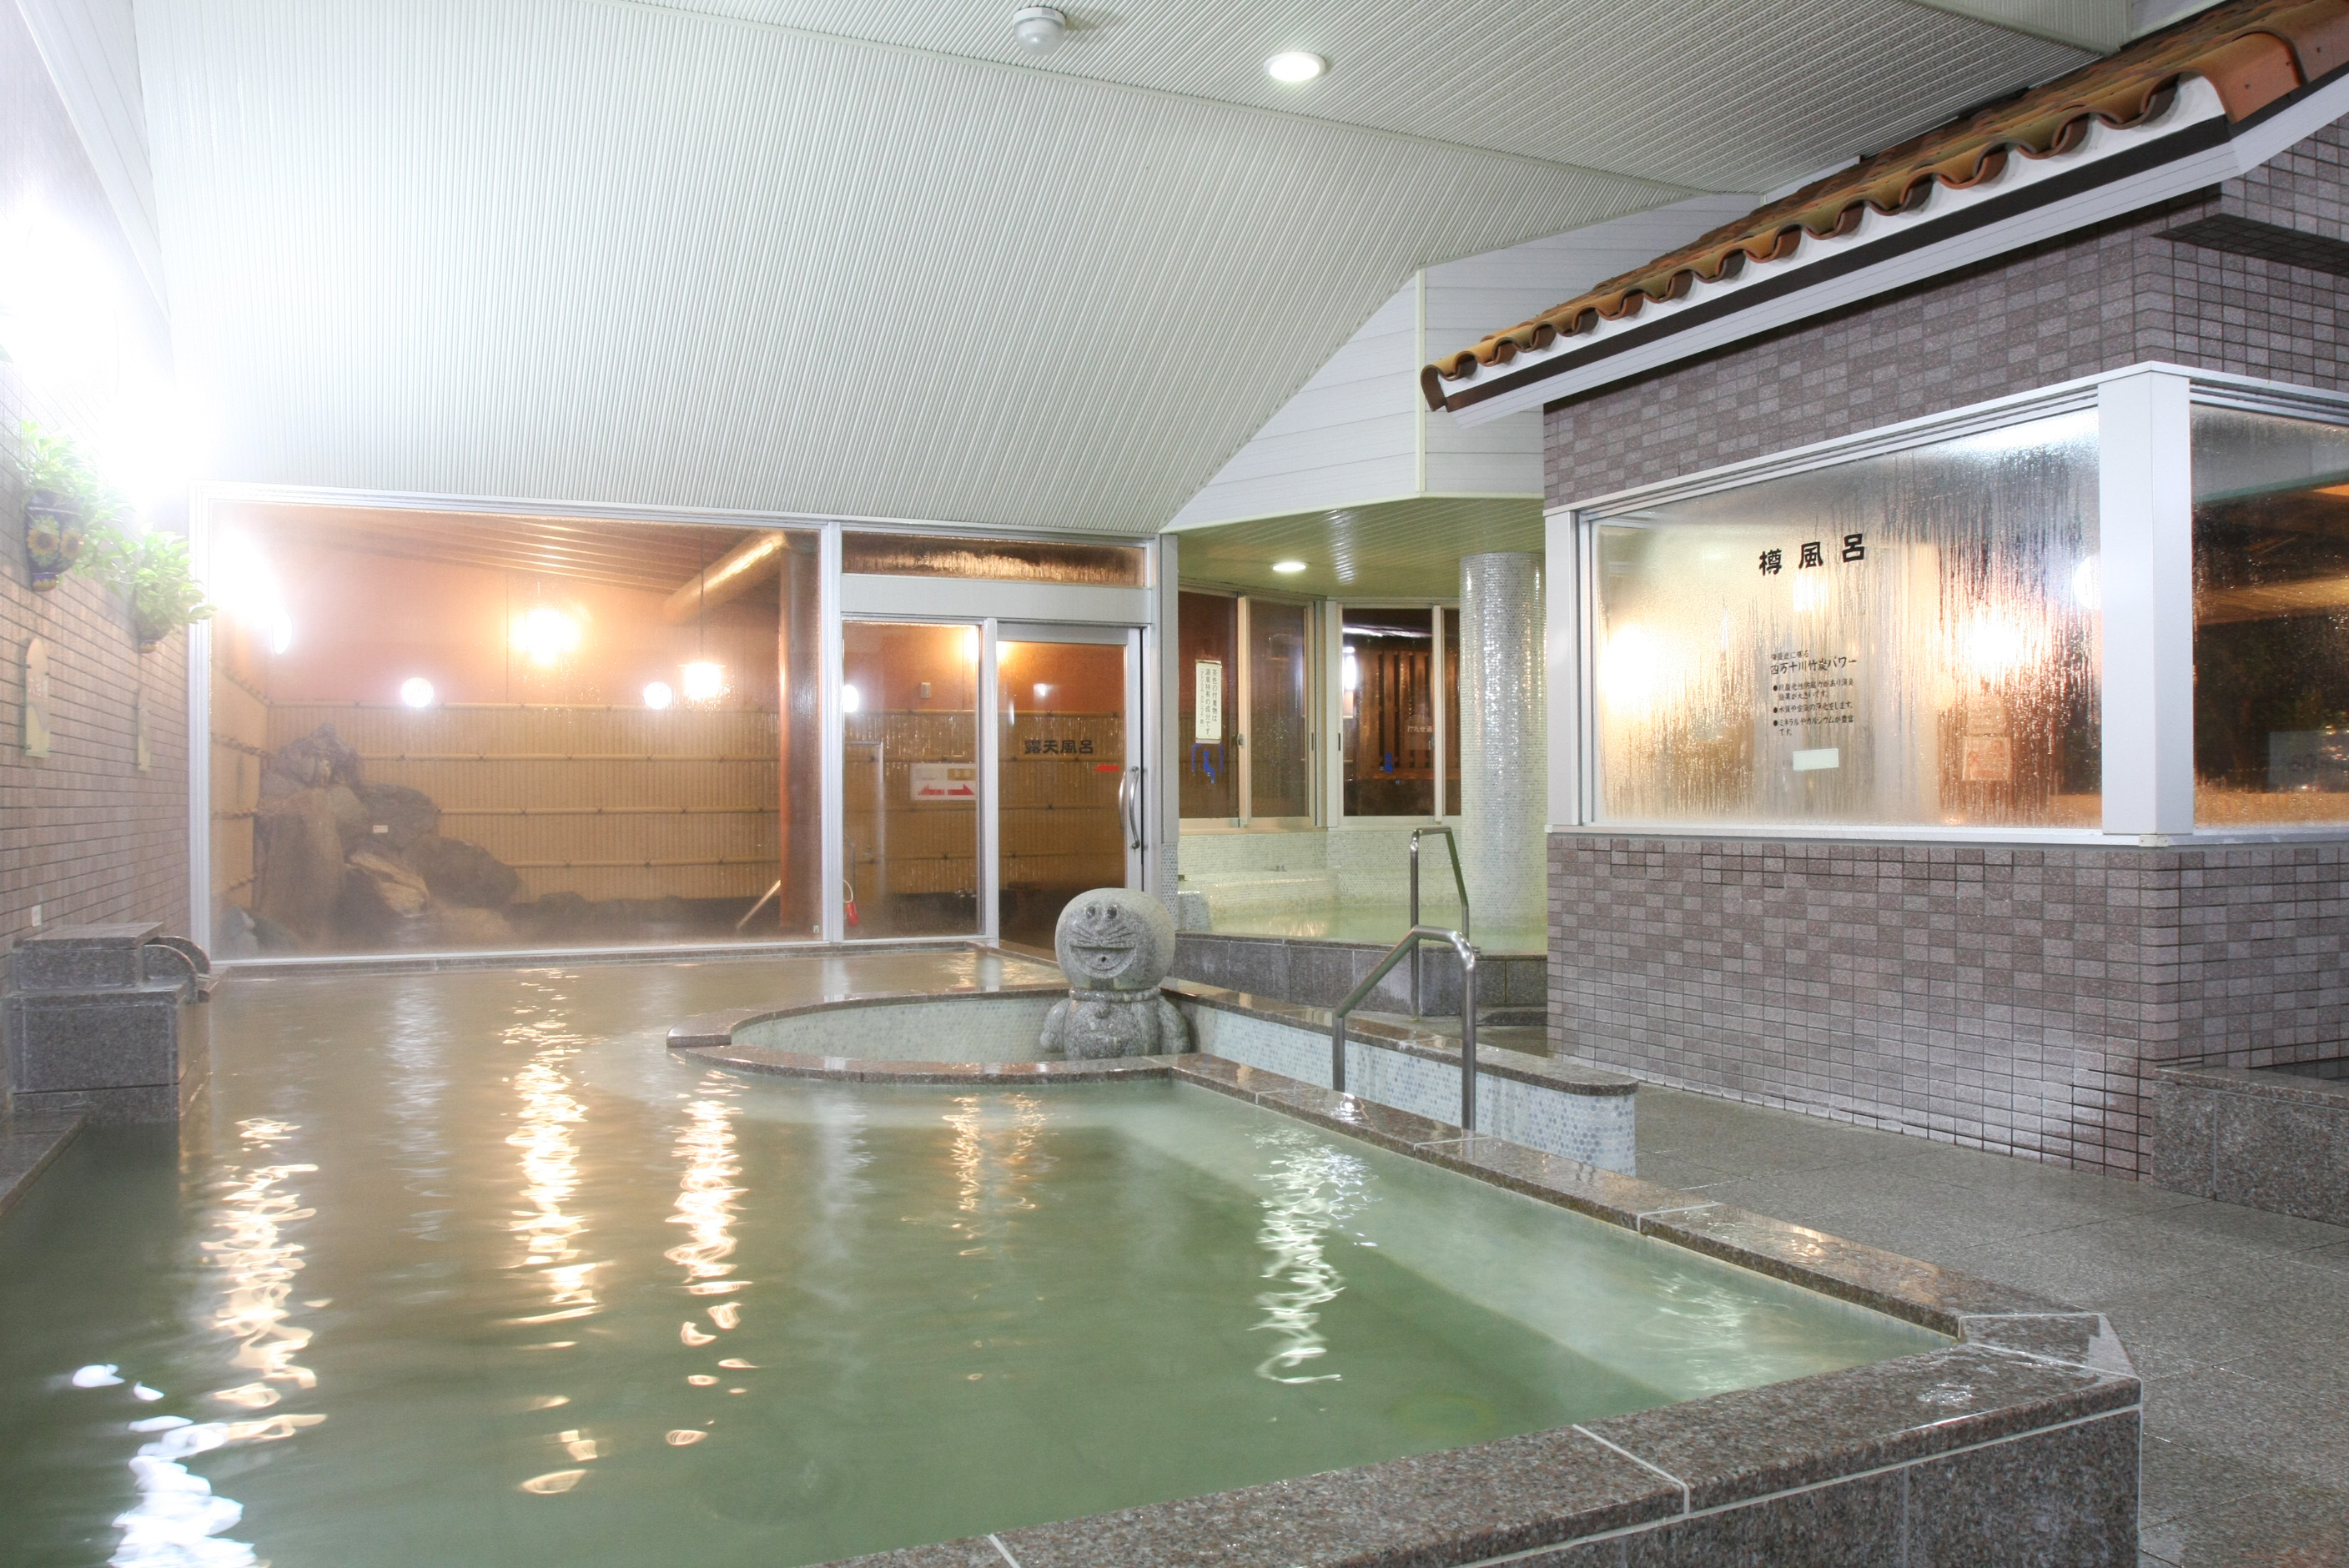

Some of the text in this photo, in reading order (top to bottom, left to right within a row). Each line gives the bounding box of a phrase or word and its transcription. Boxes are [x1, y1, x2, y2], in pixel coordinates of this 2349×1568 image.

[1759, 534, 1865, 575] 樽風呂
[1770, 656, 1857, 675] 四万十川竹炭パワー
[1779, 727, 1792, 736] です。
[1024, 740, 1094, 754] 露天風呂
